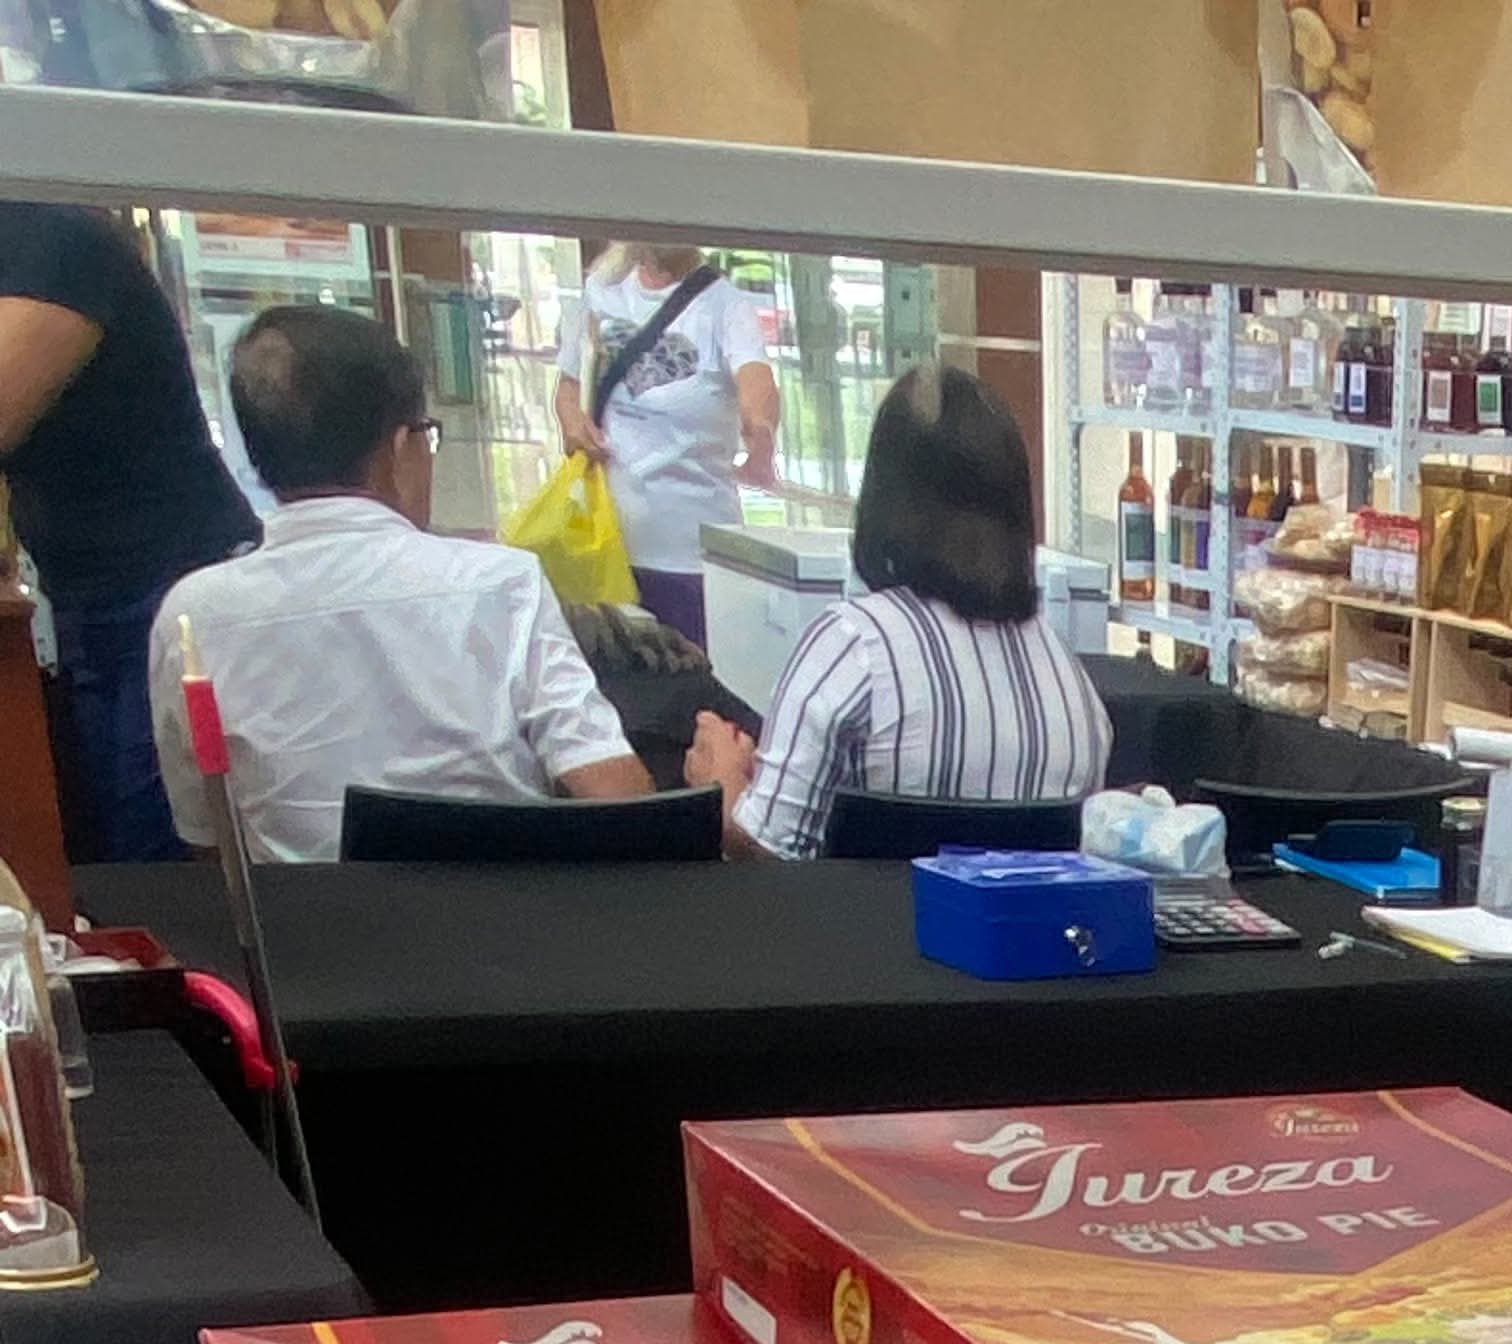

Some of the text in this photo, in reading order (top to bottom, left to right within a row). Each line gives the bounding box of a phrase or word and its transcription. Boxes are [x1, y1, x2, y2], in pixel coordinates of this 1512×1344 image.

[957, 1141, 1395, 1223] Jureza
[1080, 1213, 1212, 1240] Original
[1115, 1204, 1441, 1257] BUKO PIE
